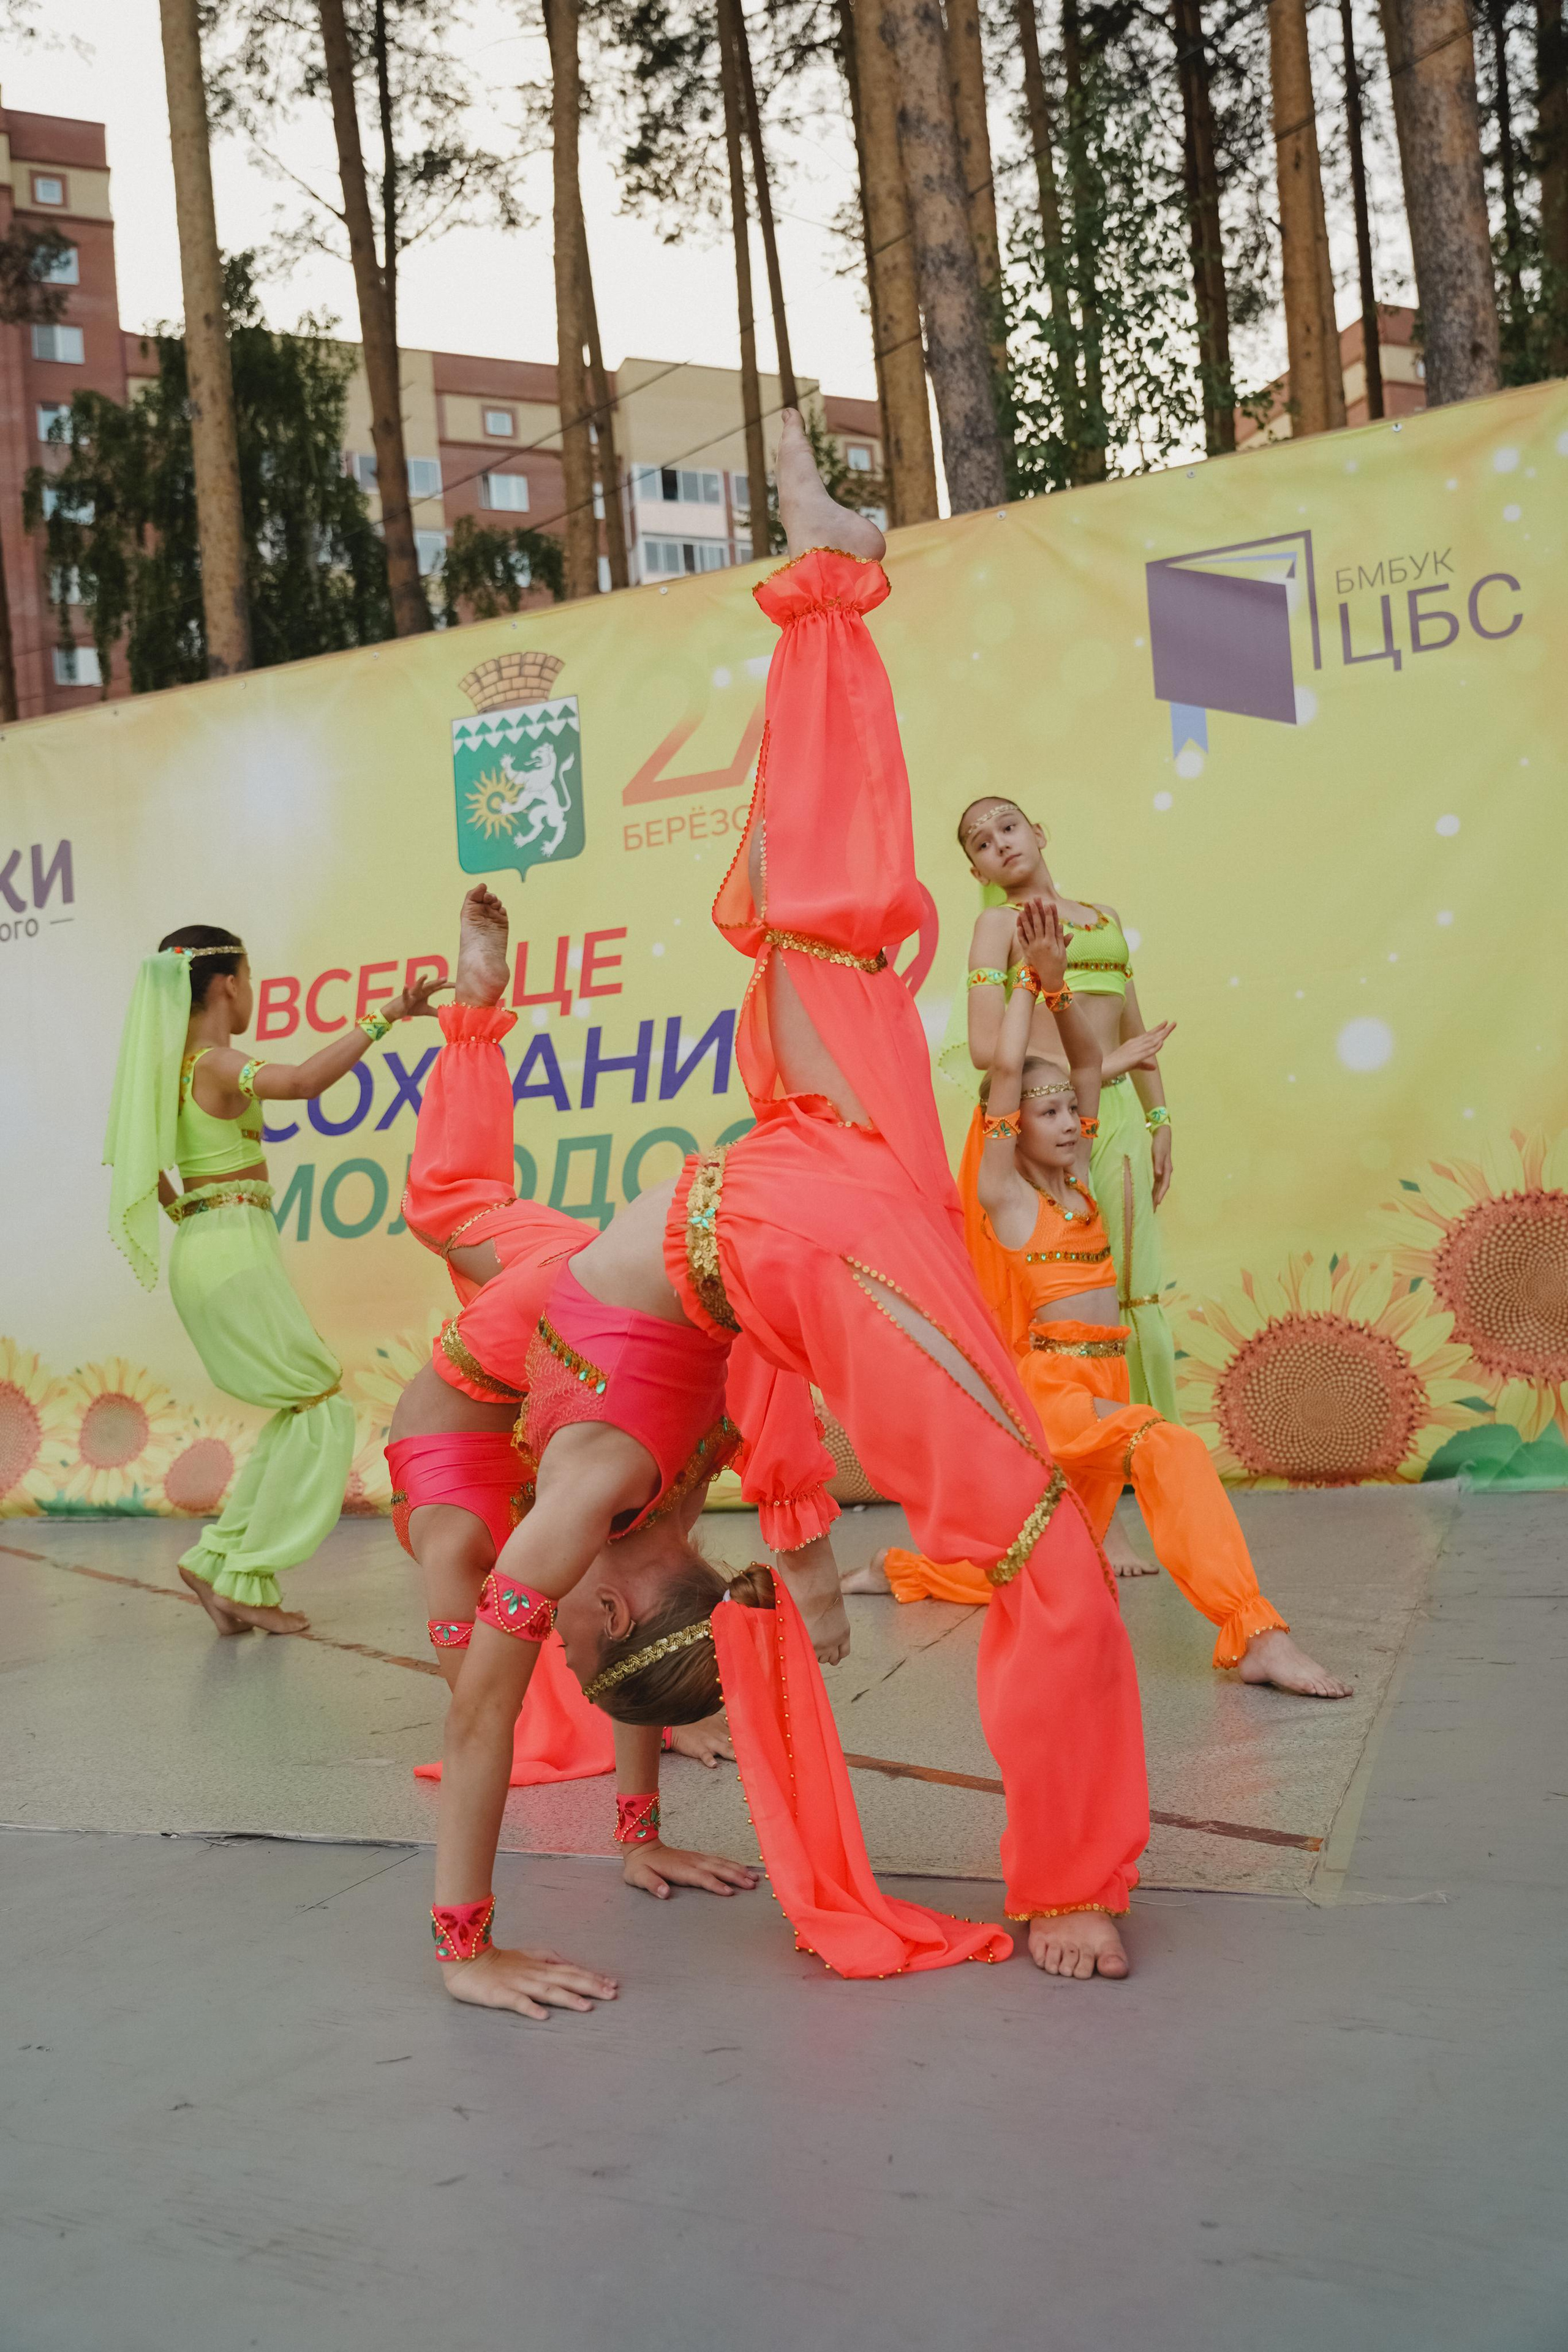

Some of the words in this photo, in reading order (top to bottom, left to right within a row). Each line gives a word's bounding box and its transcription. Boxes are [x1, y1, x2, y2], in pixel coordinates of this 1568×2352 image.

[1336, 547, 1455, 595] БМБУК
[1338, 573, 1524, 672] ЦБС
[255, 926, 628, 1042] ВСЕРЦЕ
